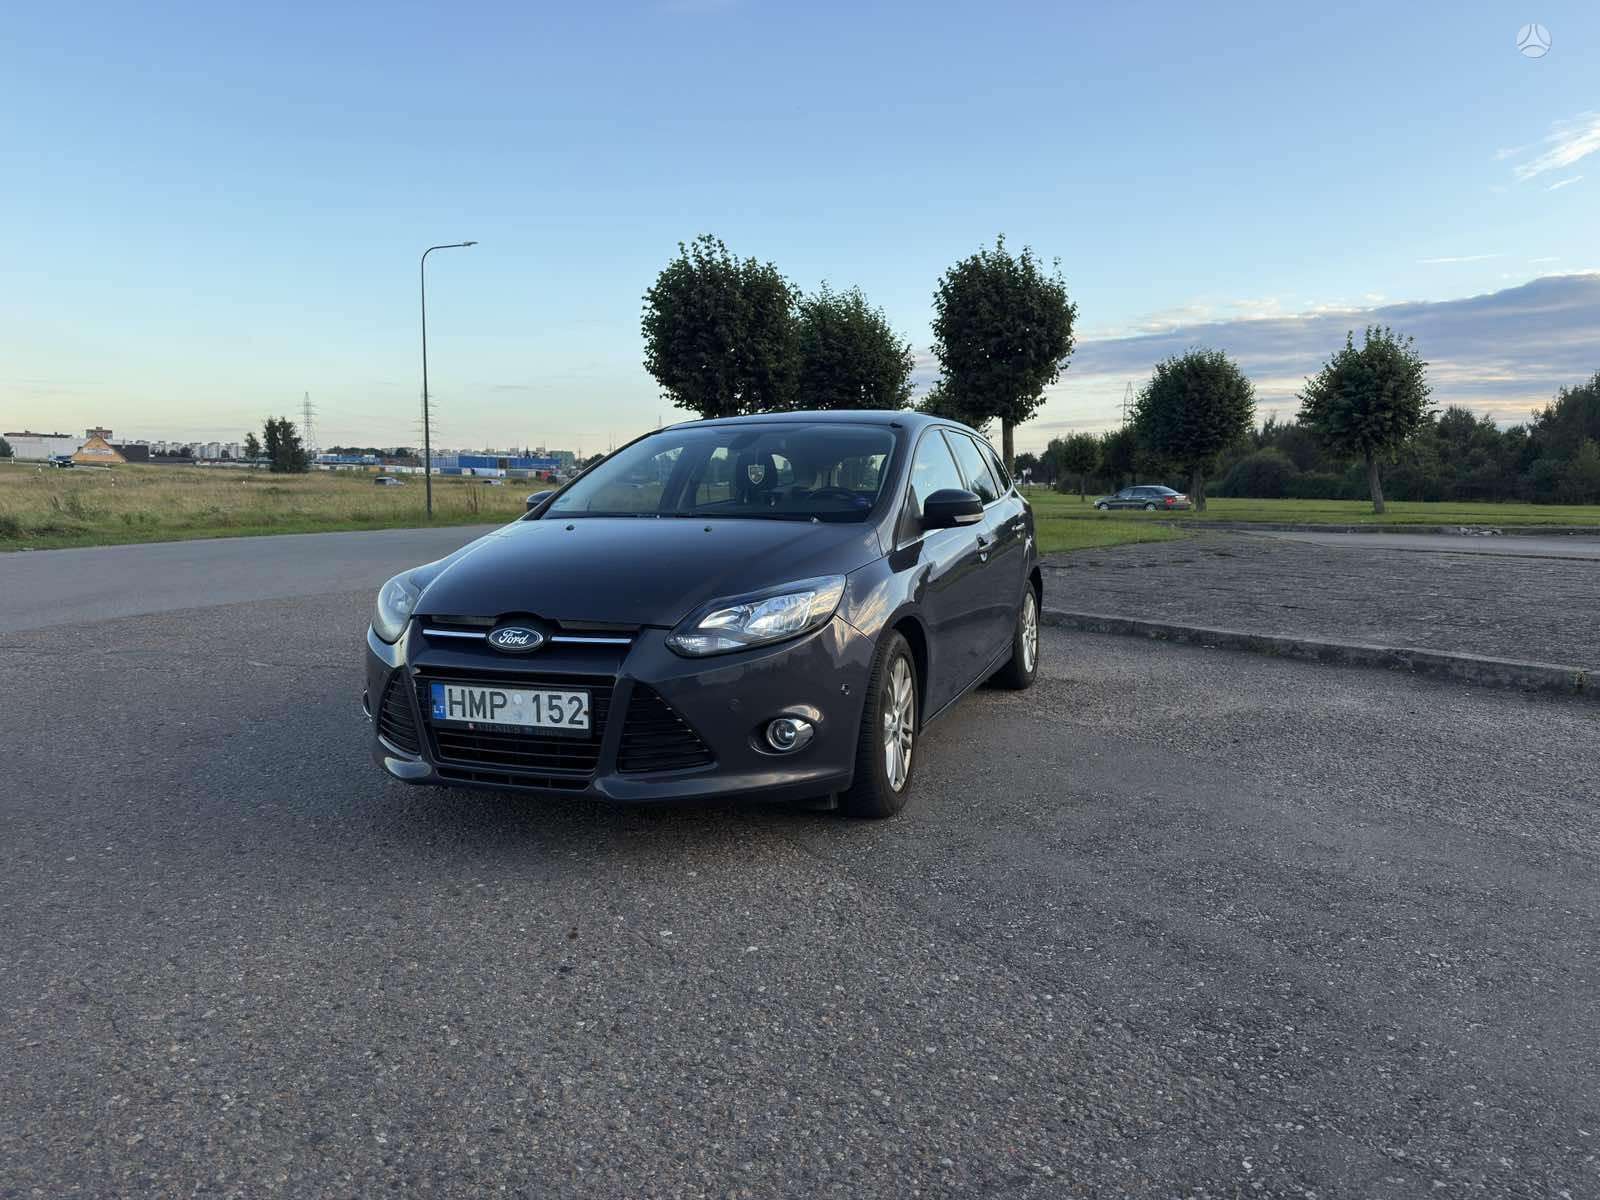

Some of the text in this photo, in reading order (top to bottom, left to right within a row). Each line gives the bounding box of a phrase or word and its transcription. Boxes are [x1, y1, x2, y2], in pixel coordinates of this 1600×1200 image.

[499, 630, 529, 644] Ford
[433, 704, 444, 713] LT
[448, 688, 584, 725] HMP 152
